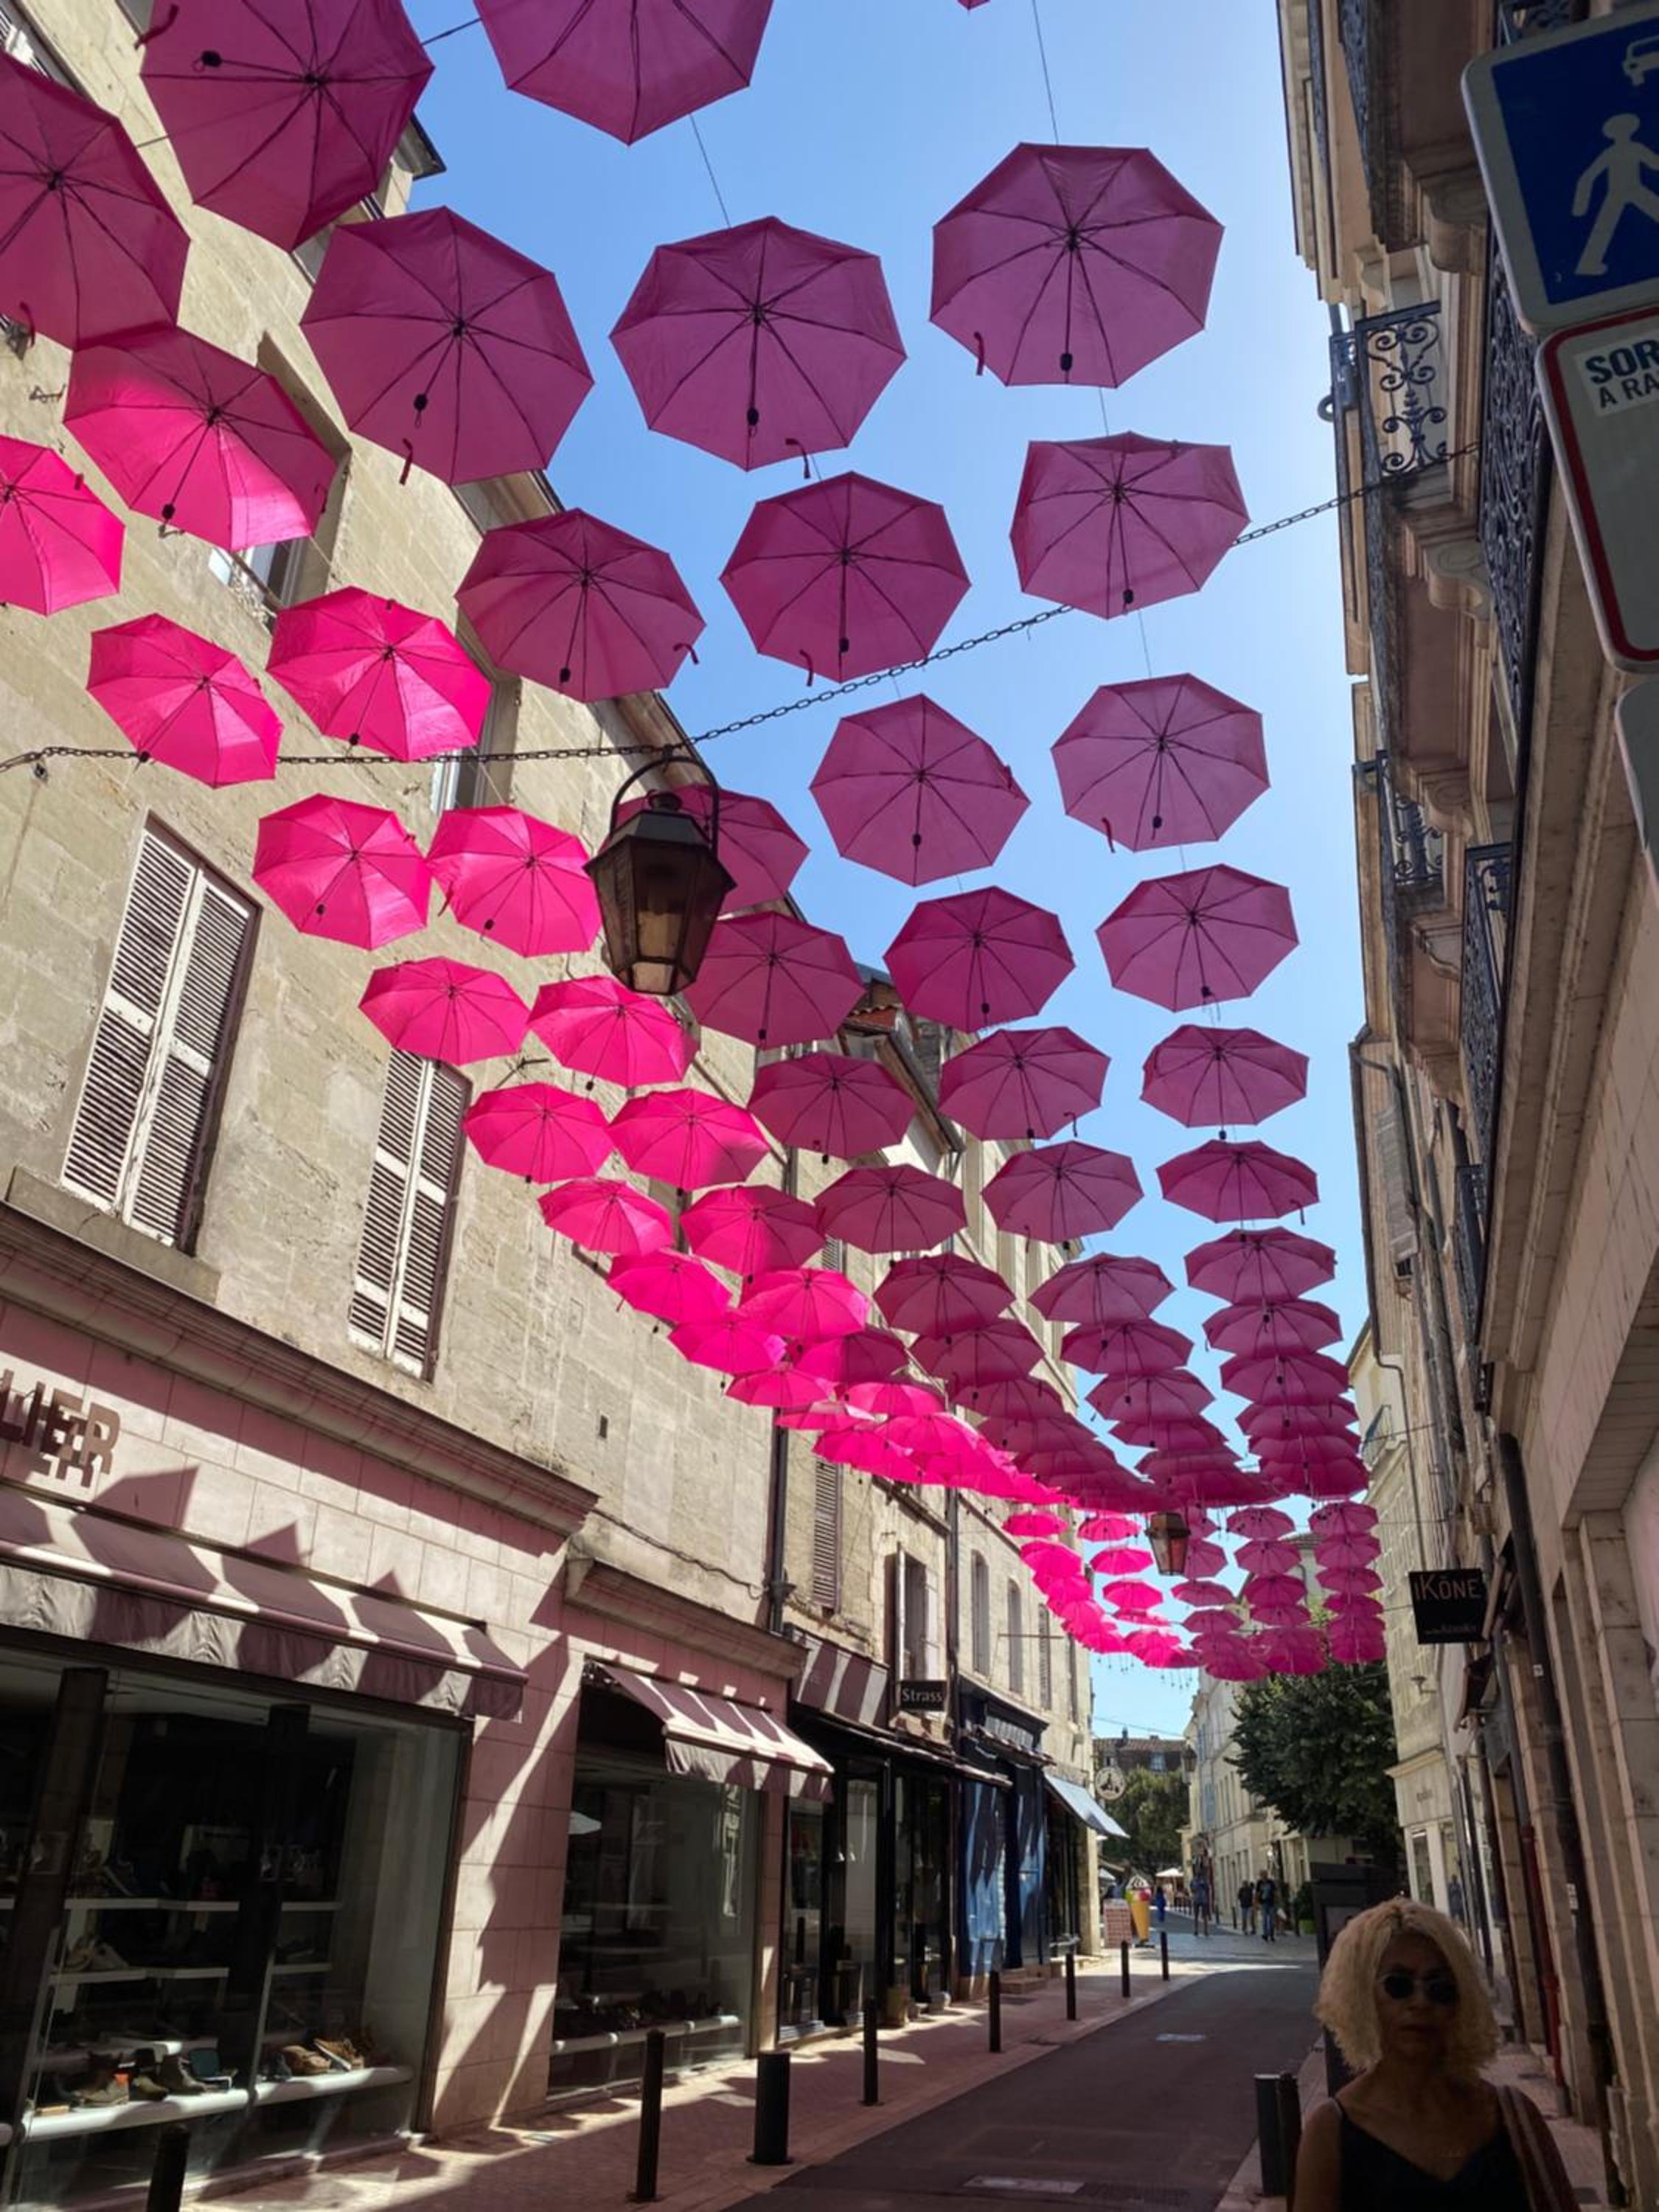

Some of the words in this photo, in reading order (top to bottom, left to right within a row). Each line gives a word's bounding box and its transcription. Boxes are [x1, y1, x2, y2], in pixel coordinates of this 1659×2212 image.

[1599, 386, 1618, 408] A
[1621, 372, 1659, 400] RA
[902, 1688, 943, 1703] Strass
